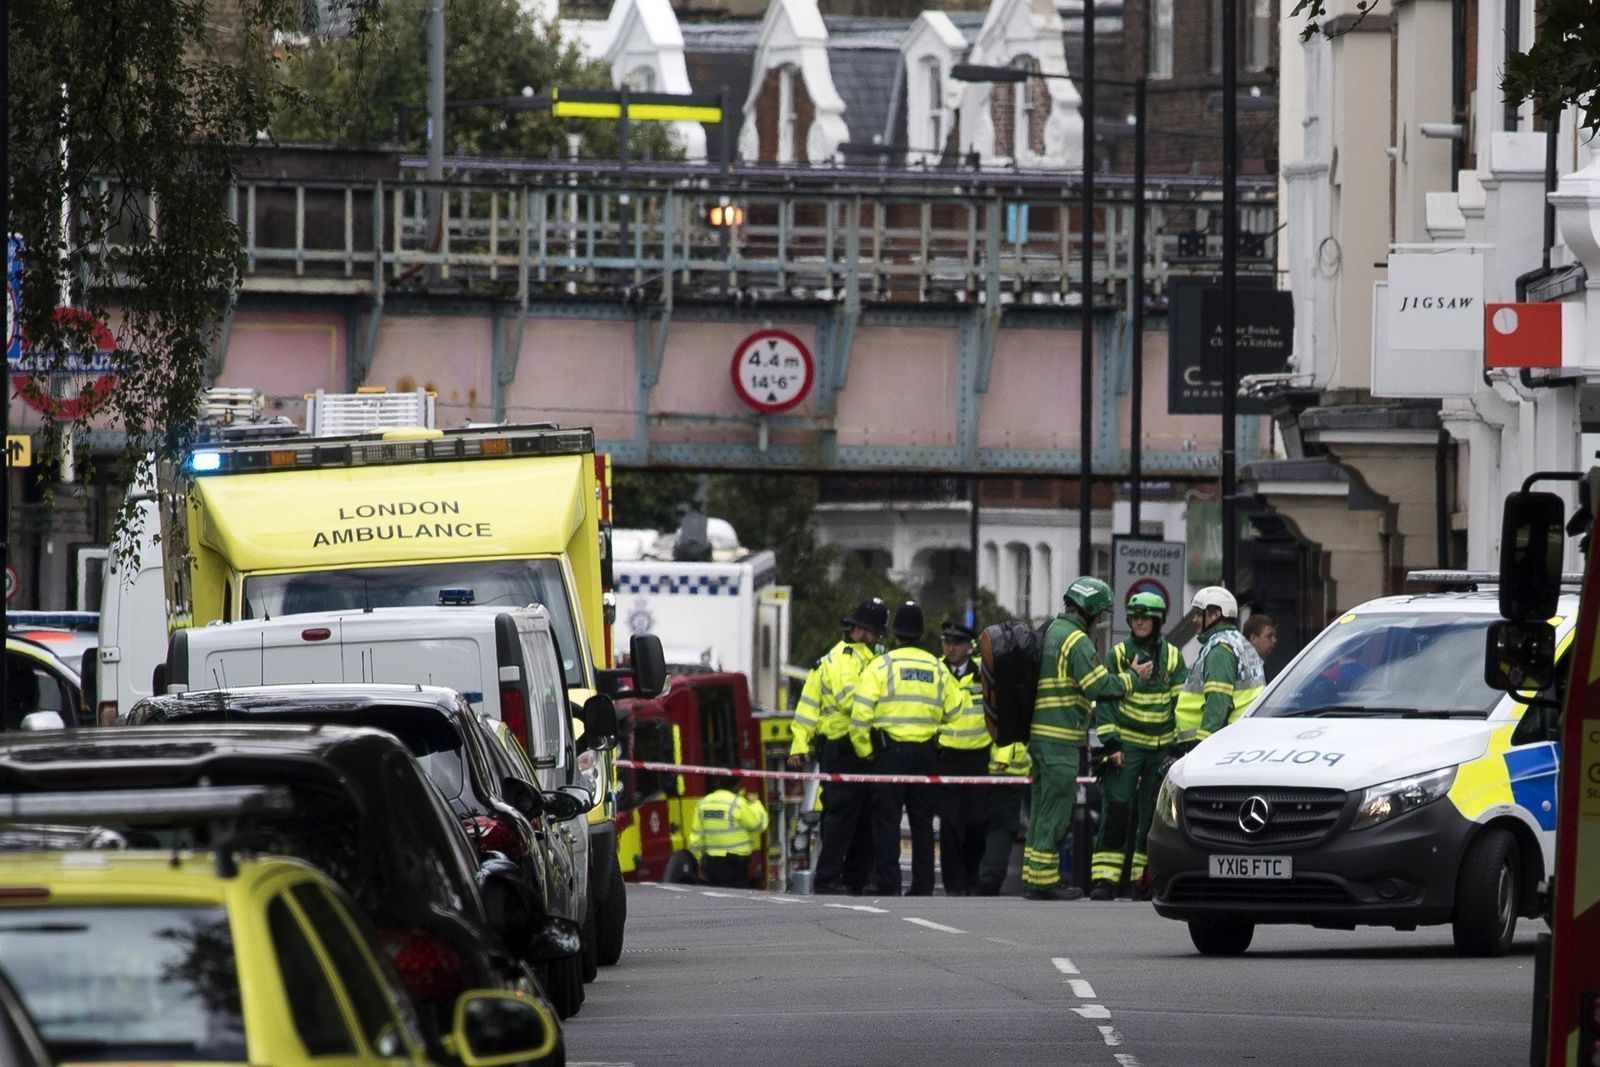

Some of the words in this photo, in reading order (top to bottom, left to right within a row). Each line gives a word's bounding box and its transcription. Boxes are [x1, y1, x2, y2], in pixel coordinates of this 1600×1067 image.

[1400, 297, 1474, 313] JIGSAW
[1249, 338, 1284, 347] Kitchen
[339, 500, 460, 520] LONDON
[313, 523, 493, 548] AMBULANCE
[1120, 545, 1181, 559] Controlled
[1127, 561, 1171, 577] ZONE
[1217, 858, 1249, 876] YX16
[1252, 859, 1282, 876] FTC
